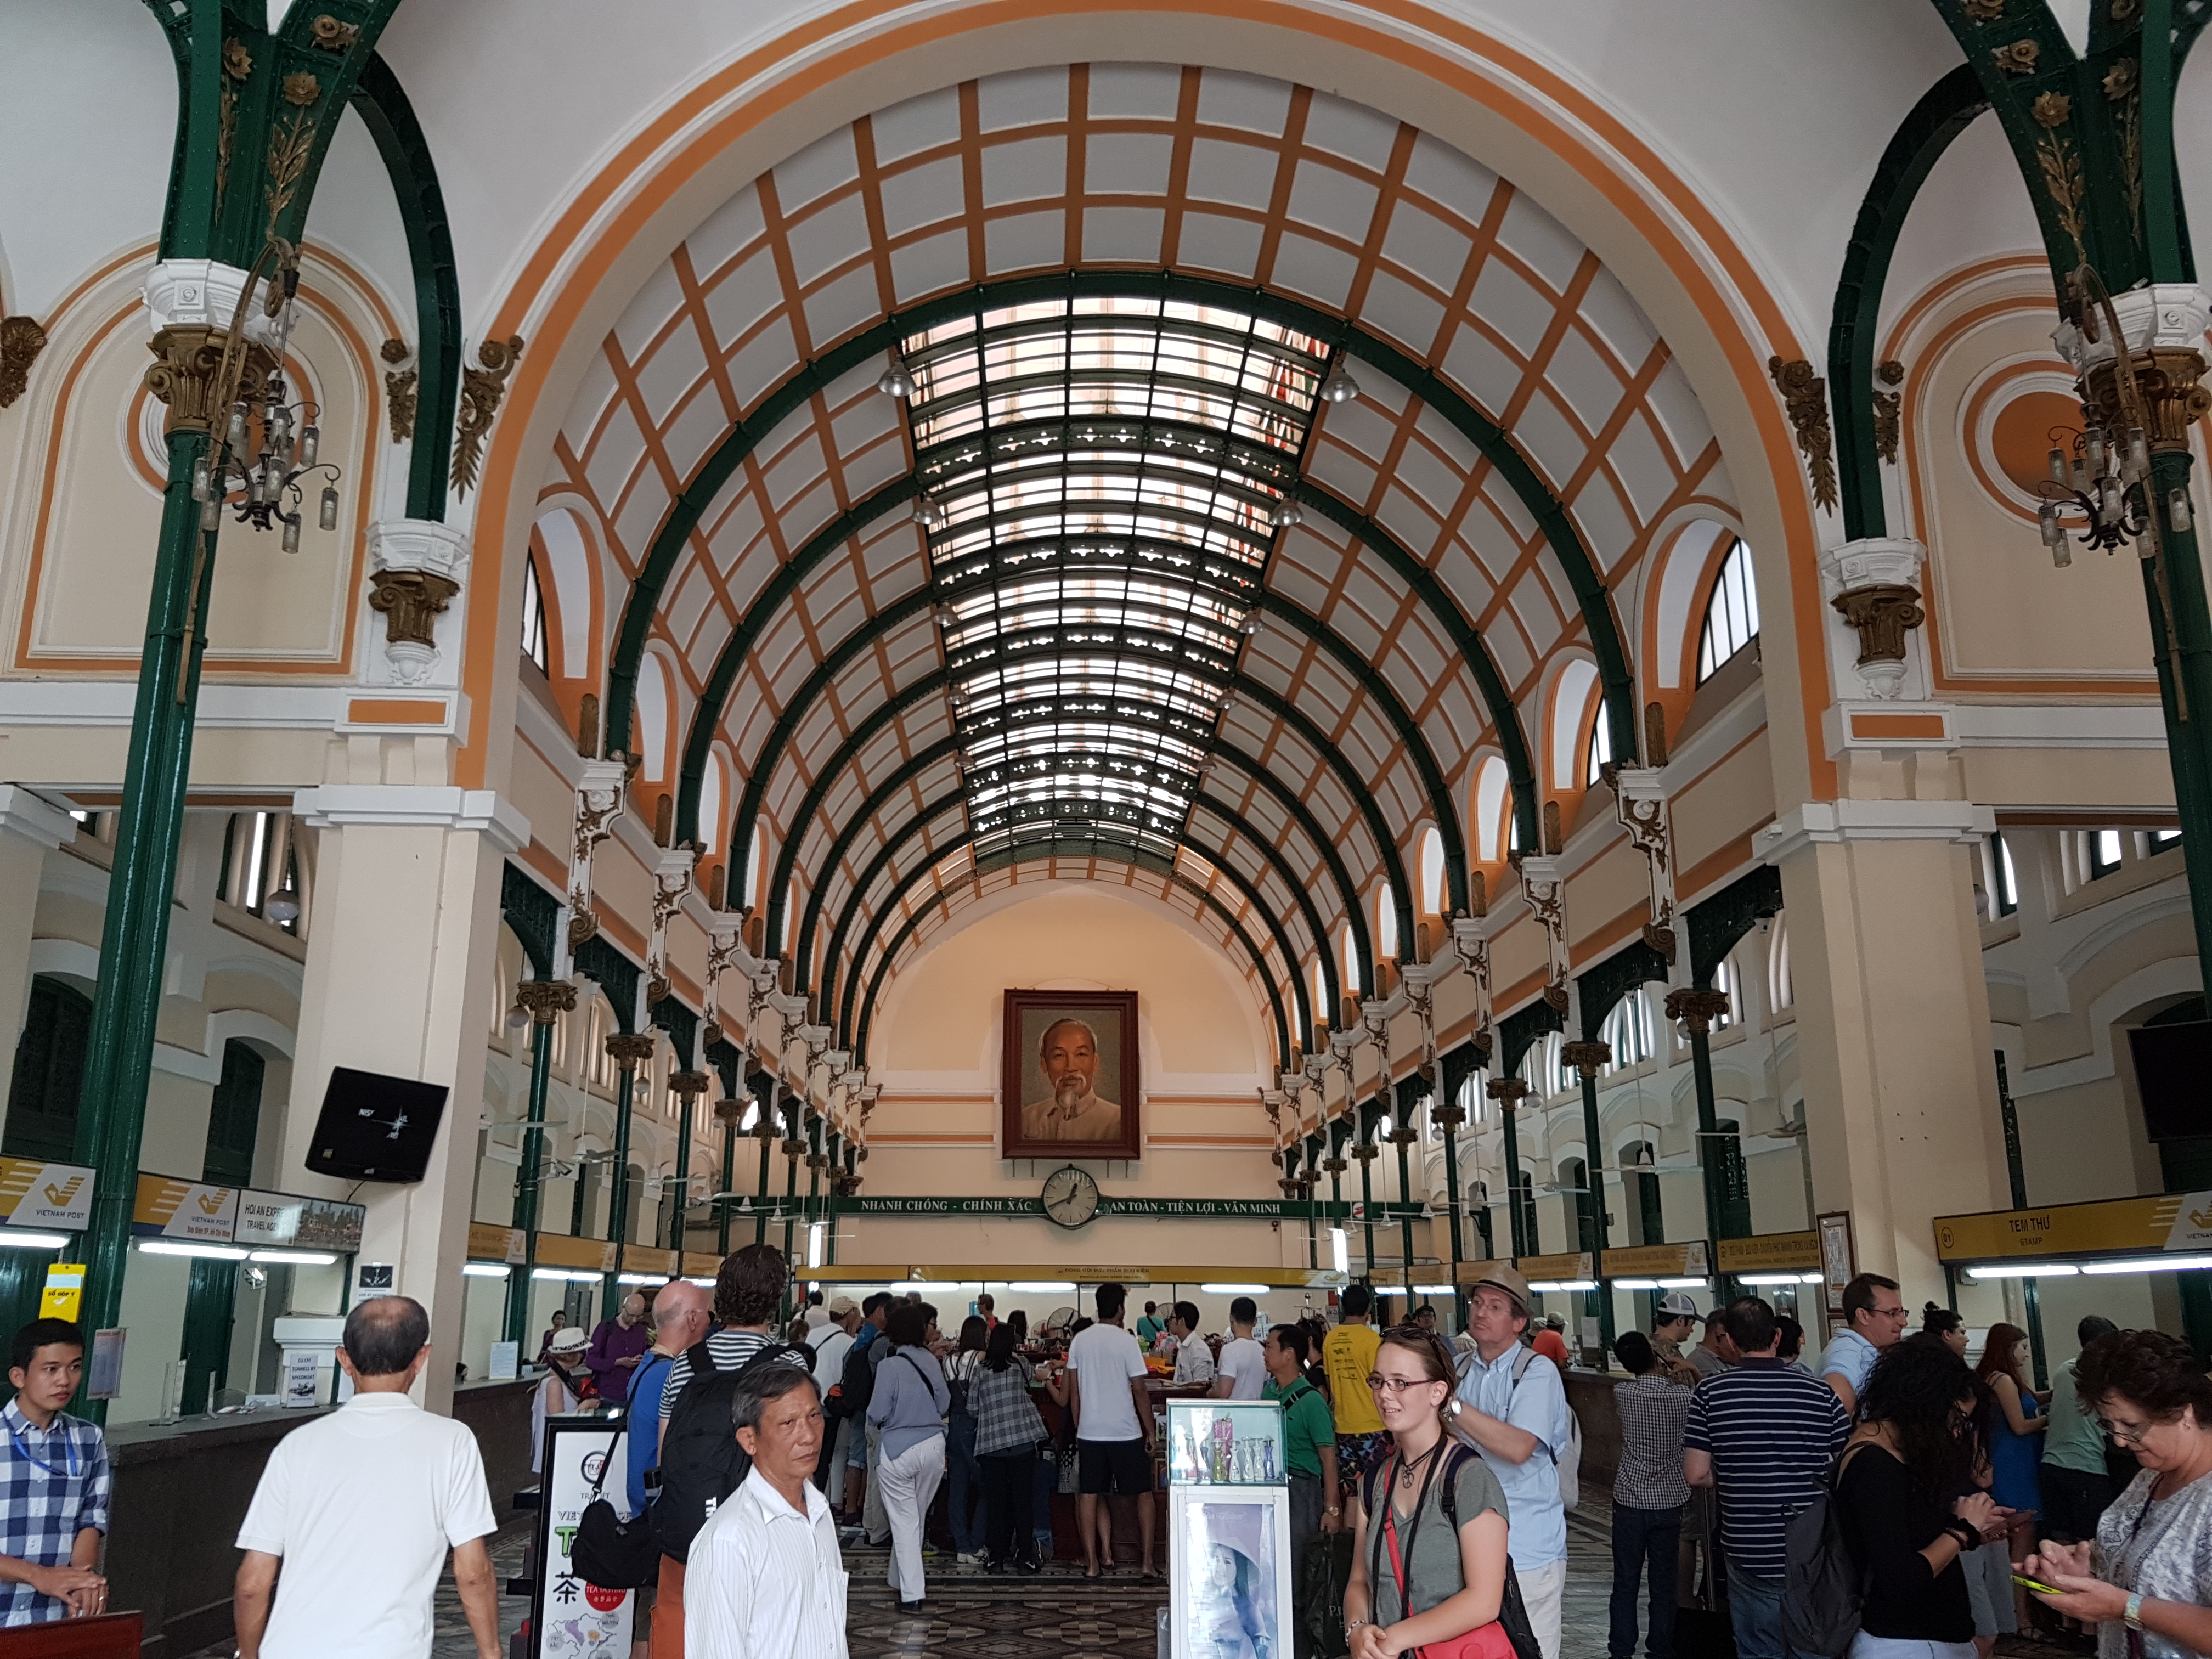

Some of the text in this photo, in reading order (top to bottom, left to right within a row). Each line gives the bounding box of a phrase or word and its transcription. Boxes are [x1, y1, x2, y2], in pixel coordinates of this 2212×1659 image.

[861, 1200, 902, 1210] NHANH
[906, 1198, 948, 1211] CHÓNG
[963, 1198, 1002, 1211] CHÍNH
[1007, 1197, 1032, 1211] XÁC
[1110, 1201, 1125, 1211] AN
[1127, 1200, 1158, 1212] TOÀN
[1166, 1200, 1193, 1214] TIỆN
[1196, 1203, 1216, 1215] LỢI
[1223, 1201, 1247, 1214] VĂN
[1250, 1203, 1280, 1214] MINH
[36, 1209, 65, 1218] VIETNAM
[256, 1205, 266, 1216] AN
[247, 1219, 266, 1230] TRAVEL
[2009, 1215, 2050, 1232] TEM THƯ
[1943, 1234, 1951, 1243] 01
[2020, 1237, 2042, 1246] STAMP
[553, 1571, 580, 1604] 茶
